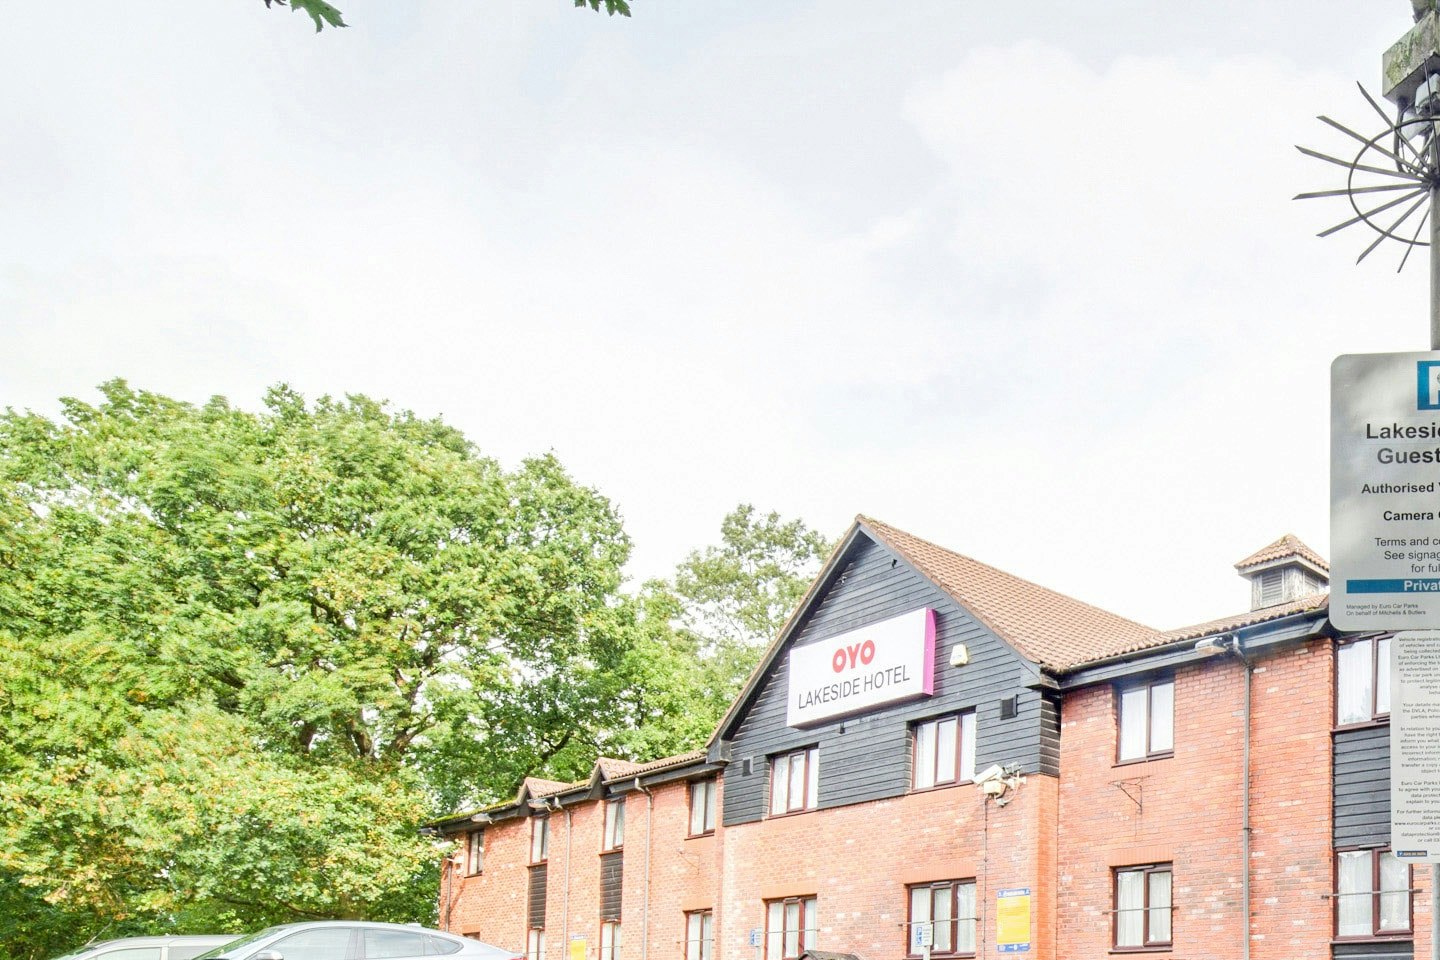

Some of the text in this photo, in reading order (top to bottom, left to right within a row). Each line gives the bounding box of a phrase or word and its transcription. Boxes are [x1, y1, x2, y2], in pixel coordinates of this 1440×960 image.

[1361, 482, 1434, 494] Authorised
[1383, 510, 1434, 521] Camera
[1375, 537, 1407, 547] Terms
[1409, 537, 1430, 547] and
[1383, 550, 1405, 560] See
[1410, 563, 1425, 573] for
[1371, 603, 1378, 611] by
[832, 640, 875, 673] OYO
[798, 664, 910, 710] LAKESIDE HOTEL
